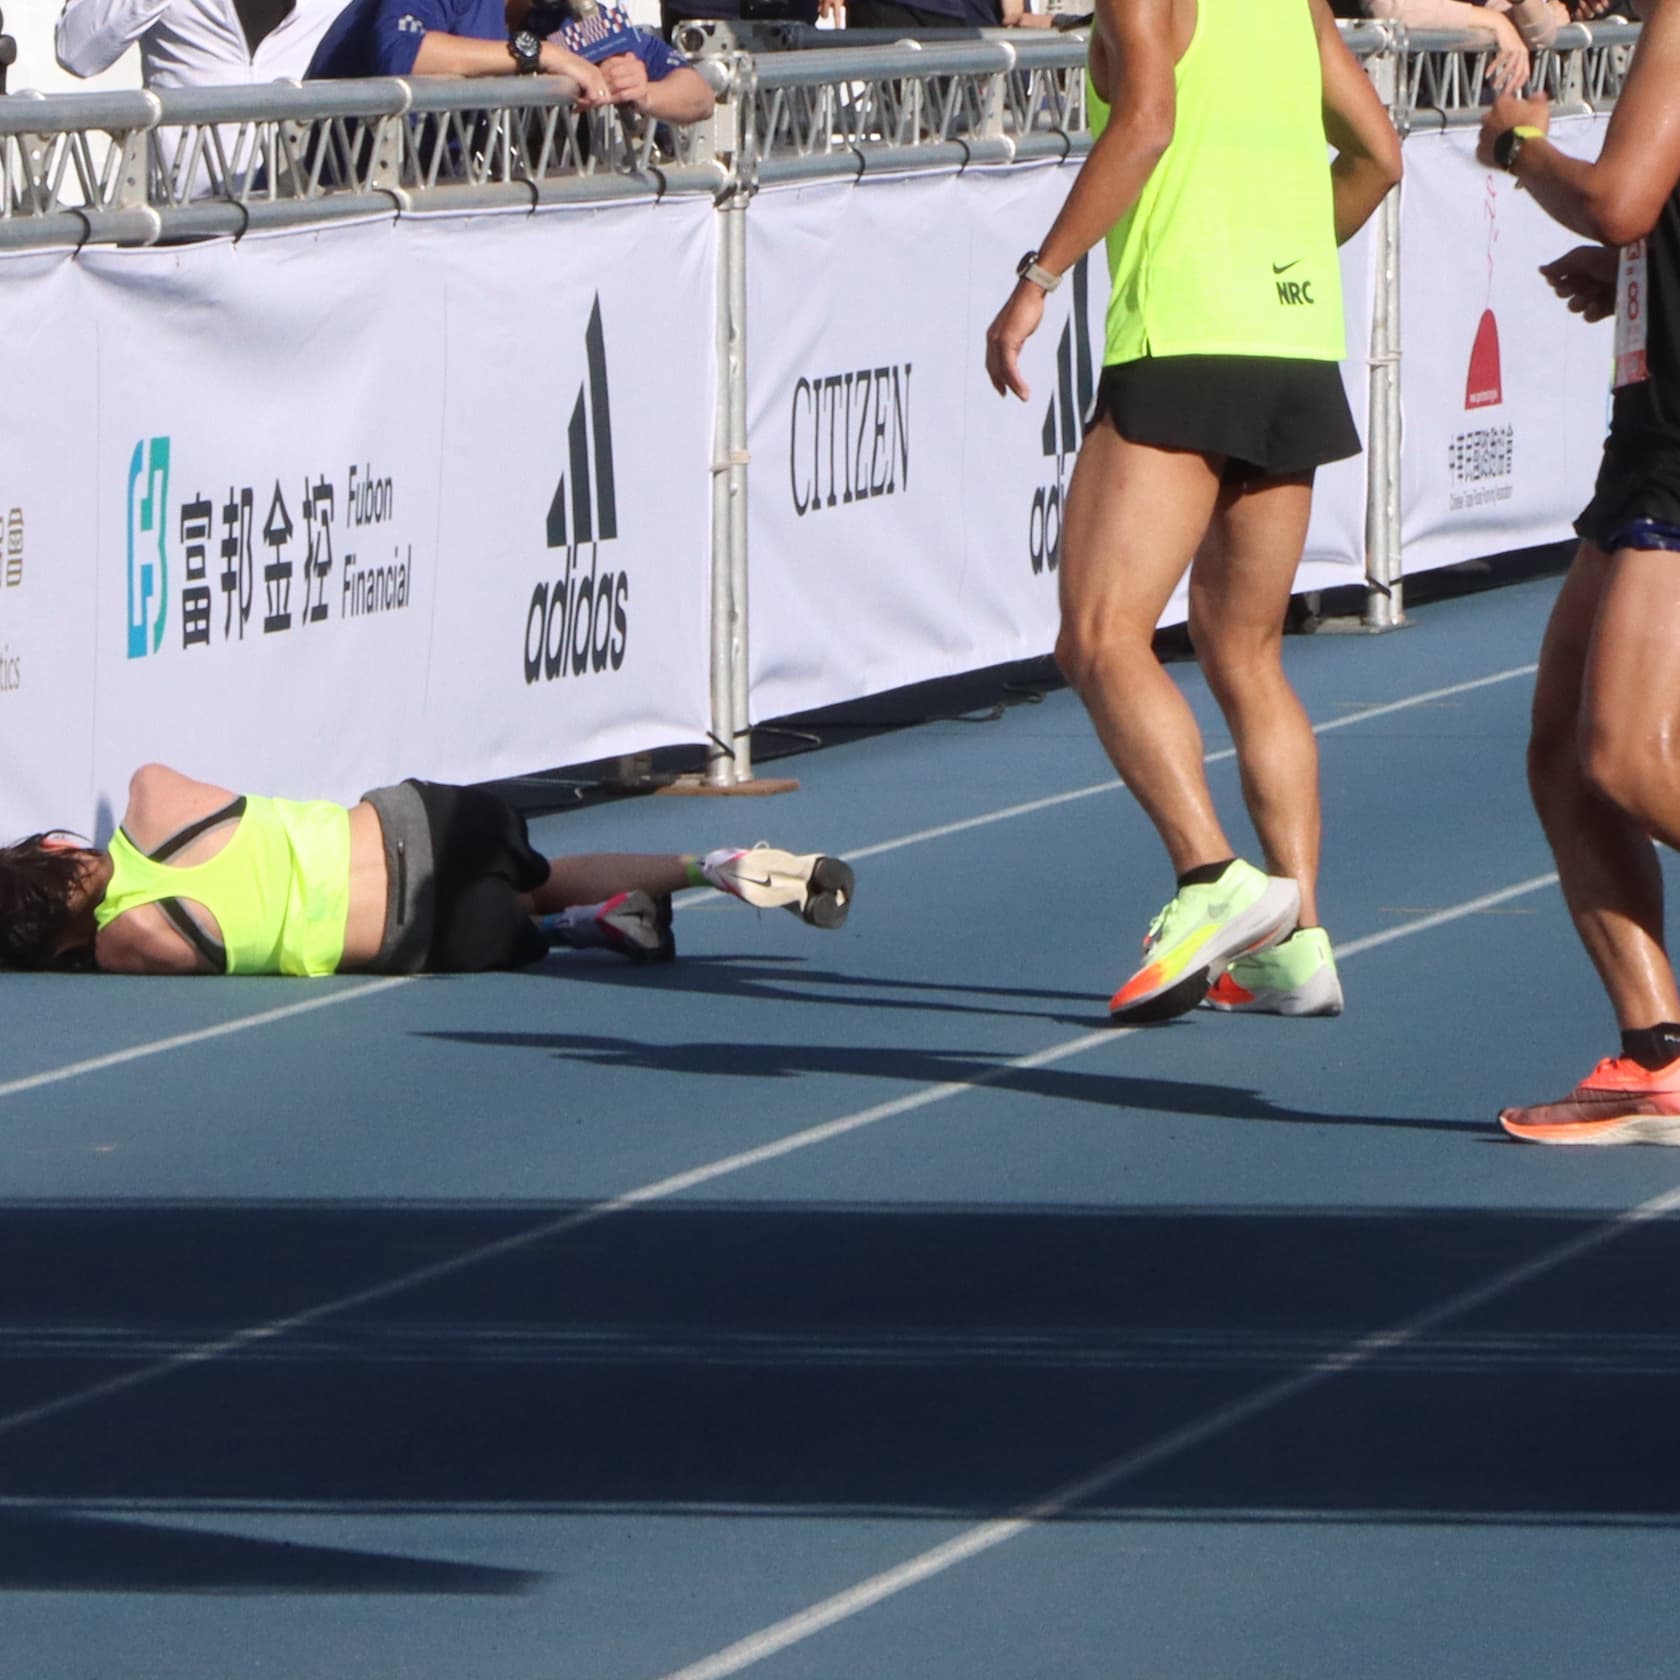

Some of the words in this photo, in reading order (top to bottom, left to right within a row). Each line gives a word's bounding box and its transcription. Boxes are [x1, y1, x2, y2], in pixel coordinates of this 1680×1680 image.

[1275, 281, 1314, 305] NRC
[348, 462, 394, 530] Fubon
[789, 363, 912, 519] CITIZEN
[179, 472, 336, 651] 富邦金控
[341, 543, 412, 620] Financial
[524, 542, 629, 685] adidas
